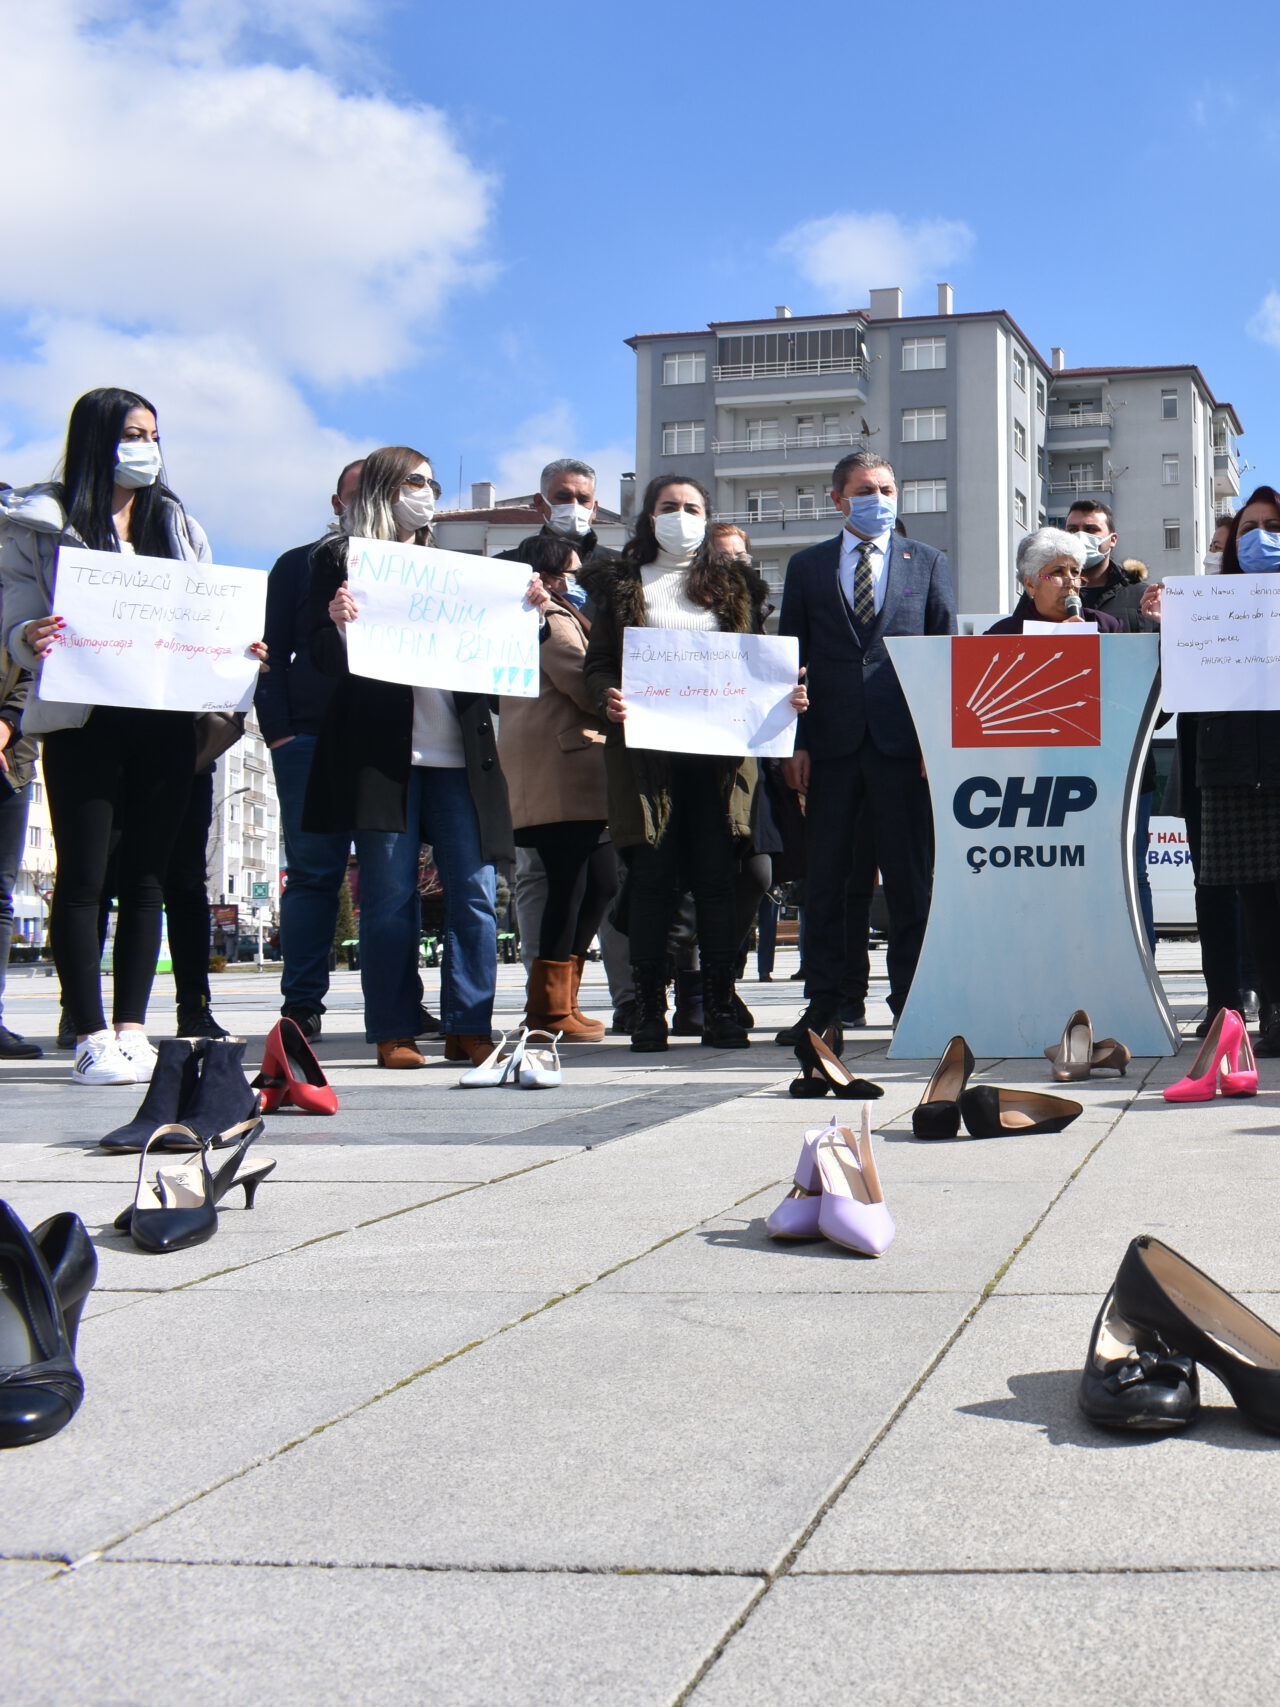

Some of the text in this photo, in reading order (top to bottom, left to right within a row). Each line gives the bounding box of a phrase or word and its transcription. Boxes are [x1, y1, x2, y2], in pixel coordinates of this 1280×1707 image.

[70, 566, 242, 598] TECAVÜZCÜ DEVLET
[406, 593, 485, 628] BENİM
[680, 685, 718, 698] LÜTFEN
[723, 682, 747, 697] ÖLME
[953, 776, 1098, 830] CHP
[966, 844, 1085, 874] ÇORUM
